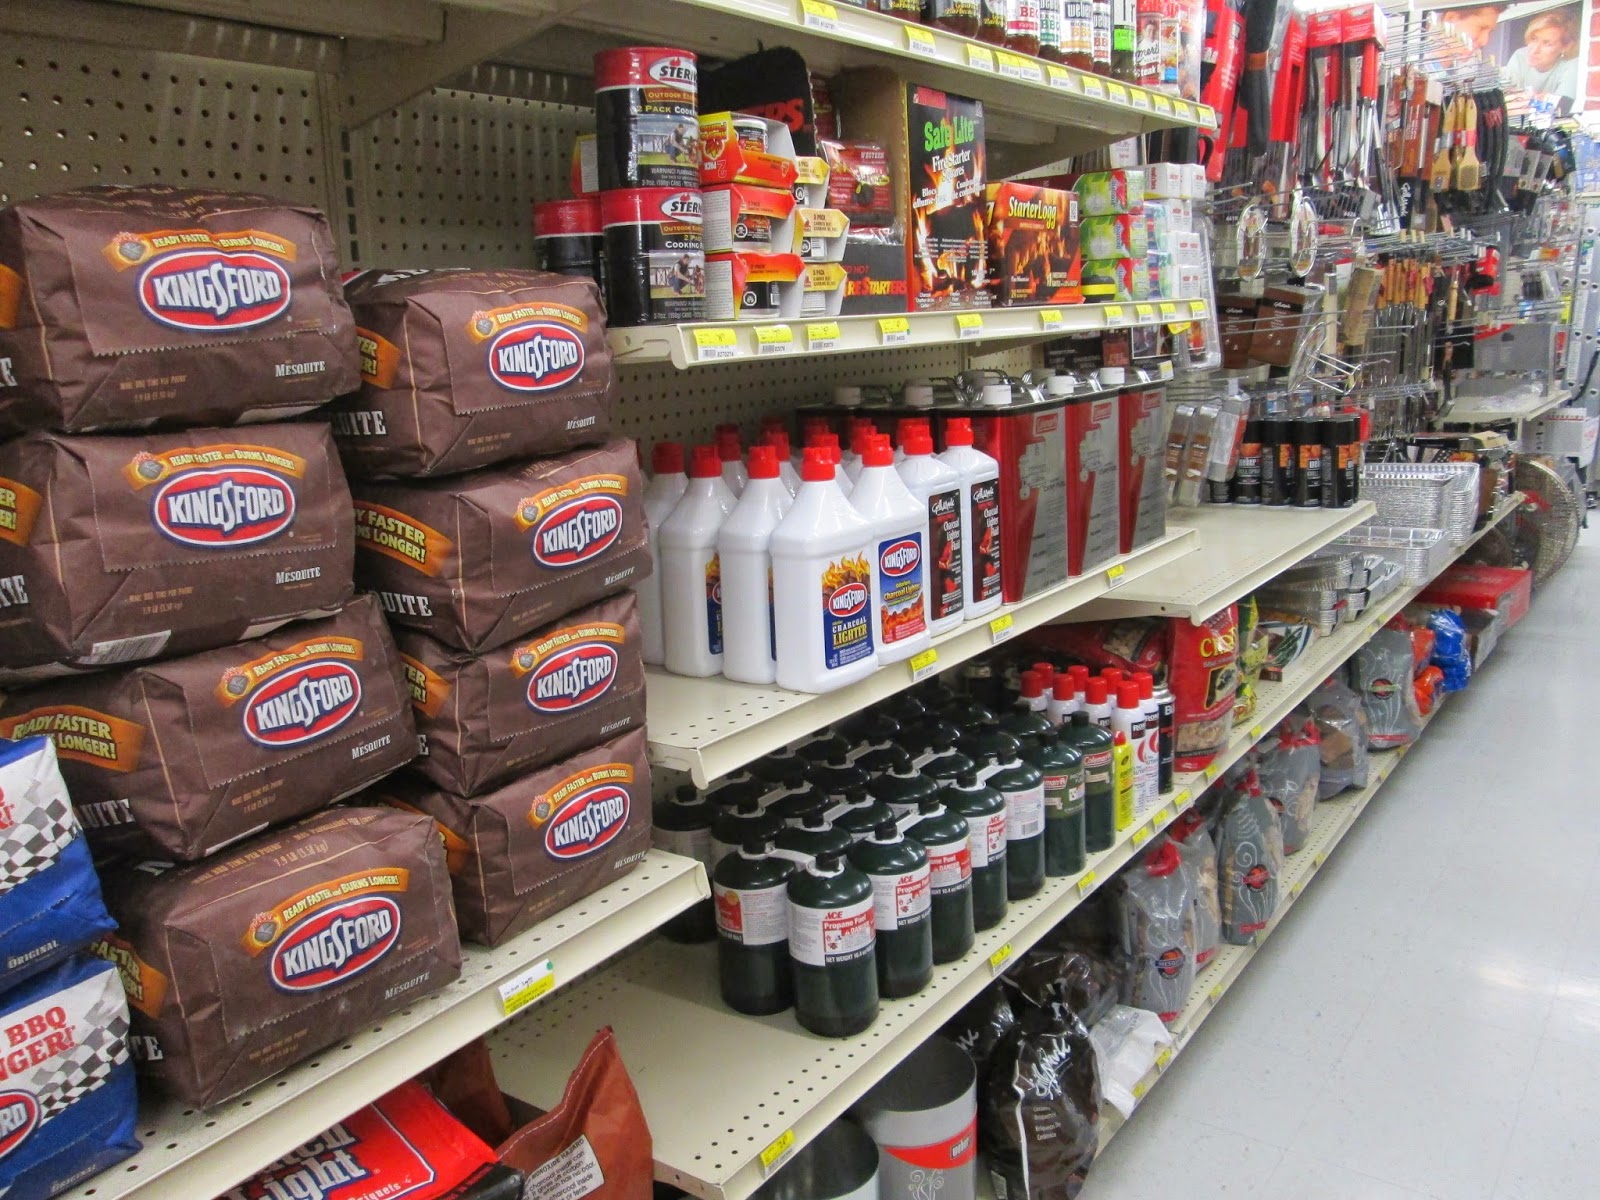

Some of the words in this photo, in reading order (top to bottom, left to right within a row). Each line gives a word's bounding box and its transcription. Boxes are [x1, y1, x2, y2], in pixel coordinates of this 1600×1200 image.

[925, 121, 950, 151] Safe
[954, 117, 974, 144] Lite
[1009, 196, 1056, 229] StarterLogg
[153, 237, 181, 248] READY
[182, 233, 213, 246] FASTER
[222, 235, 250, 248] BURNS
[250, 236, 287, 254] LONGER!
[665, 241, 699, 249] COOKING
[152, 262, 282, 316] KINGSFORD
[513, 308, 535, 319] FASTER
[498, 335, 579, 379] KINGSFORD
[275, 361, 326, 377] MESQUITE
[170, 455, 193, 467] READY
[194, 451, 223, 463] FASTER
[236, 450, 262, 460] BURNS
[263, 452, 295, 470] LONGER!
[168, 481, 285, 532] KINGSFORD
[984, 505, 998, 518] Charcoal
[368, 511, 426, 545] FASTER
[542, 509, 617, 551] KINGSFORD
[943, 519, 960, 531] Charcoal
[987, 516, 998, 527] Lighter
[373, 530, 426, 564] LONGER!
[946, 530, 960, 543] Lighter
[884, 545, 918, 569] KINGSFORD
[275, 567, 321, 584] MESQUITE
[832, 588, 865, 611] KINGSFORD
[883, 588, 906, 602] Charcoal
[832, 618, 867, 634] CHARCOAL
[537, 641, 553, 653] READY
[833, 628, 867, 646] LIGHTER
[254, 659, 274, 676] READY
[275, 652, 299, 667] FASTER
[309, 643, 328, 655] BURNS
[328, 641, 356, 655] LONGER!
[537, 655, 612, 699] KINGSFORD
[256, 674, 353, 731] KINGSFORD
[12, 714, 53, 739] READY
[55, 714, 113, 739] FASTER
[58, 734, 117, 760] LONGER!
[351, 735, 391, 759] MESQUITE
[1085, 752, 1112, 765] Coleman
[567, 778, 586, 793] FASTER
[554, 796, 624, 847] KINGSFORD
[989, 816, 1001, 825] ACE
[274, 858, 289, 868] 7.9
[944, 855, 956, 864] Fuel
[897, 881, 922, 895] Propane
[899, 875, 914, 885] ACE
[283, 901, 307, 922] READY
[307, 888, 332, 909] FASTER
[341, 877, 368, 895] BURNS
[370, 874, 400, 888] LONGER!
[824, 920, 854, 930] Propane
[854, 914, 867, 926] Fuel
[825, 911, 843, 919] ACE
[282, 907, 392, 979] KINGSFORD
[8, 940, 59, 969] ORIGINAL
[384, 971, 430, 1000] MESQUITE
[3, 1006, 68, 1048] BBQ
[561, 1138, 585, 1159] HAZARD
[529, 1171, 556, 1191] charcoal
[573, 1151, 585, 1161] can
[562, 1160, 584, 1176] carbon
[549, 1182, 577, 1200] charcoal
[577, 1172, 594, 1185] inside
[561, 1175, 572, 1185] has
